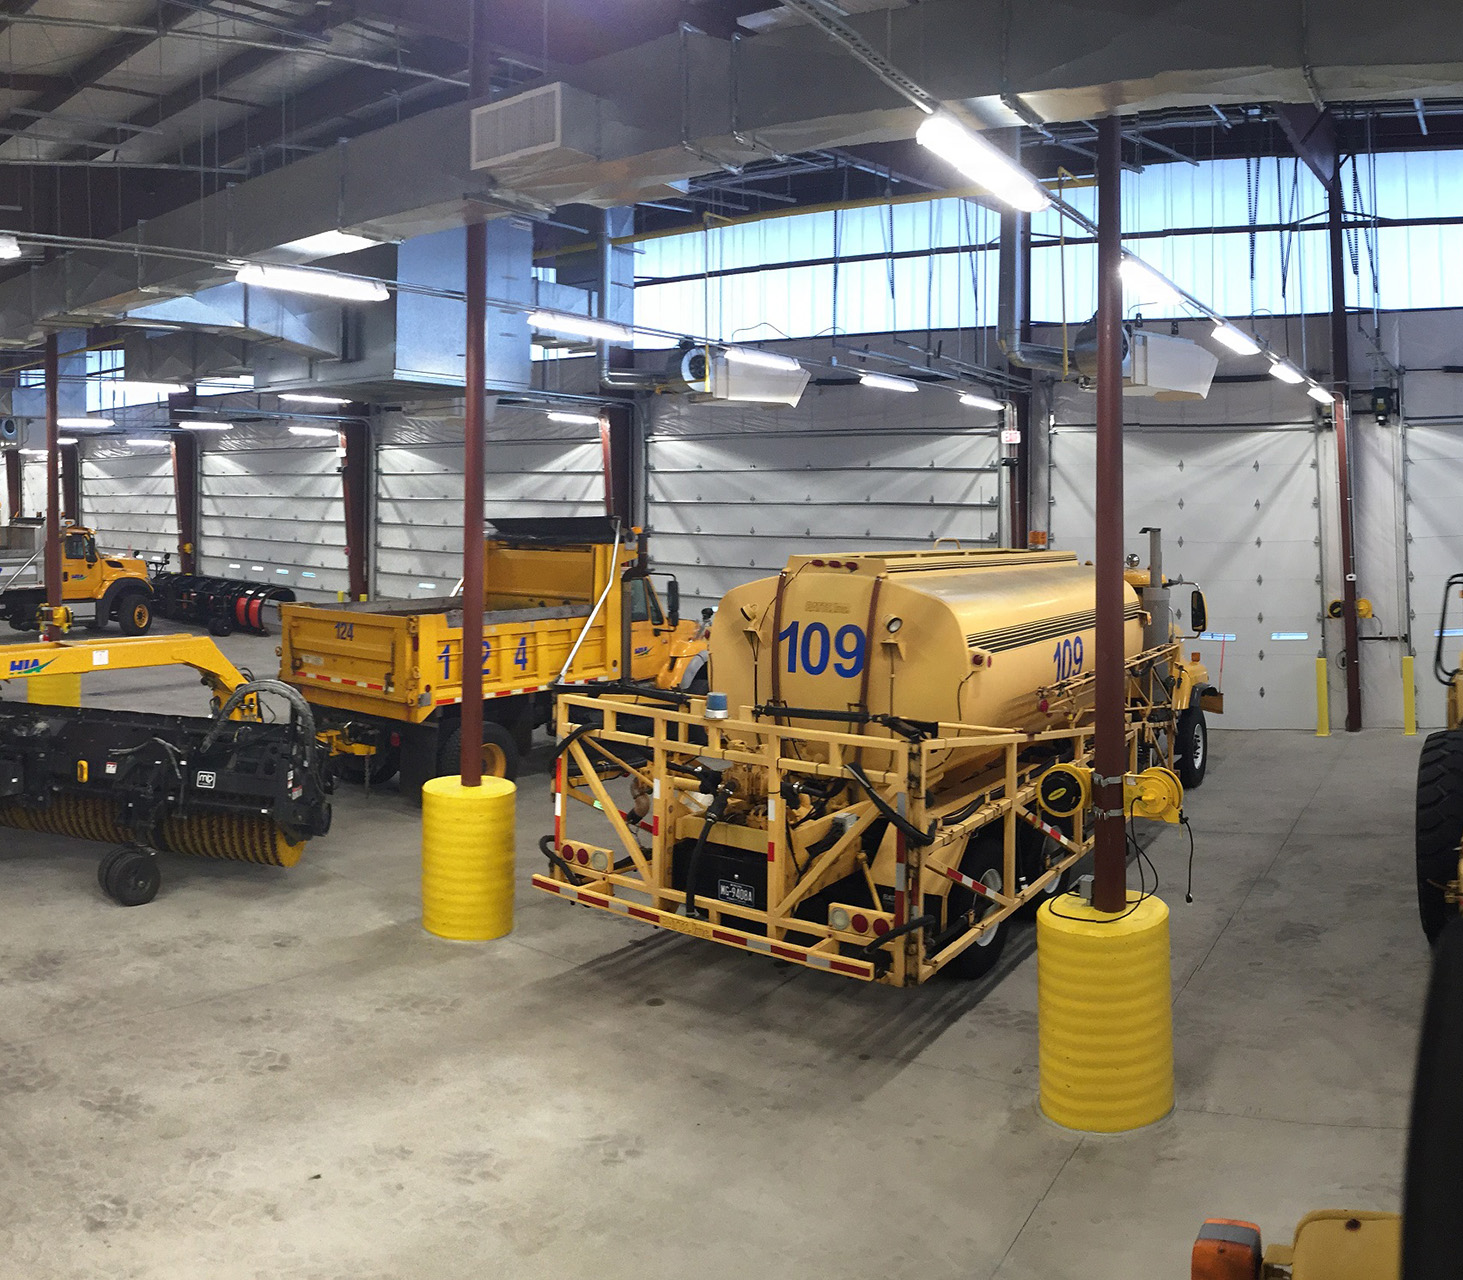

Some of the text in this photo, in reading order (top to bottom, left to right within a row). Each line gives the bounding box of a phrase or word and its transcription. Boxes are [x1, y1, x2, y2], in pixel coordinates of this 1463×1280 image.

[334, 622, 354, 641] 124
[778, 620, 866, 678] 109
[1053, 635, 1083, 683] 109
